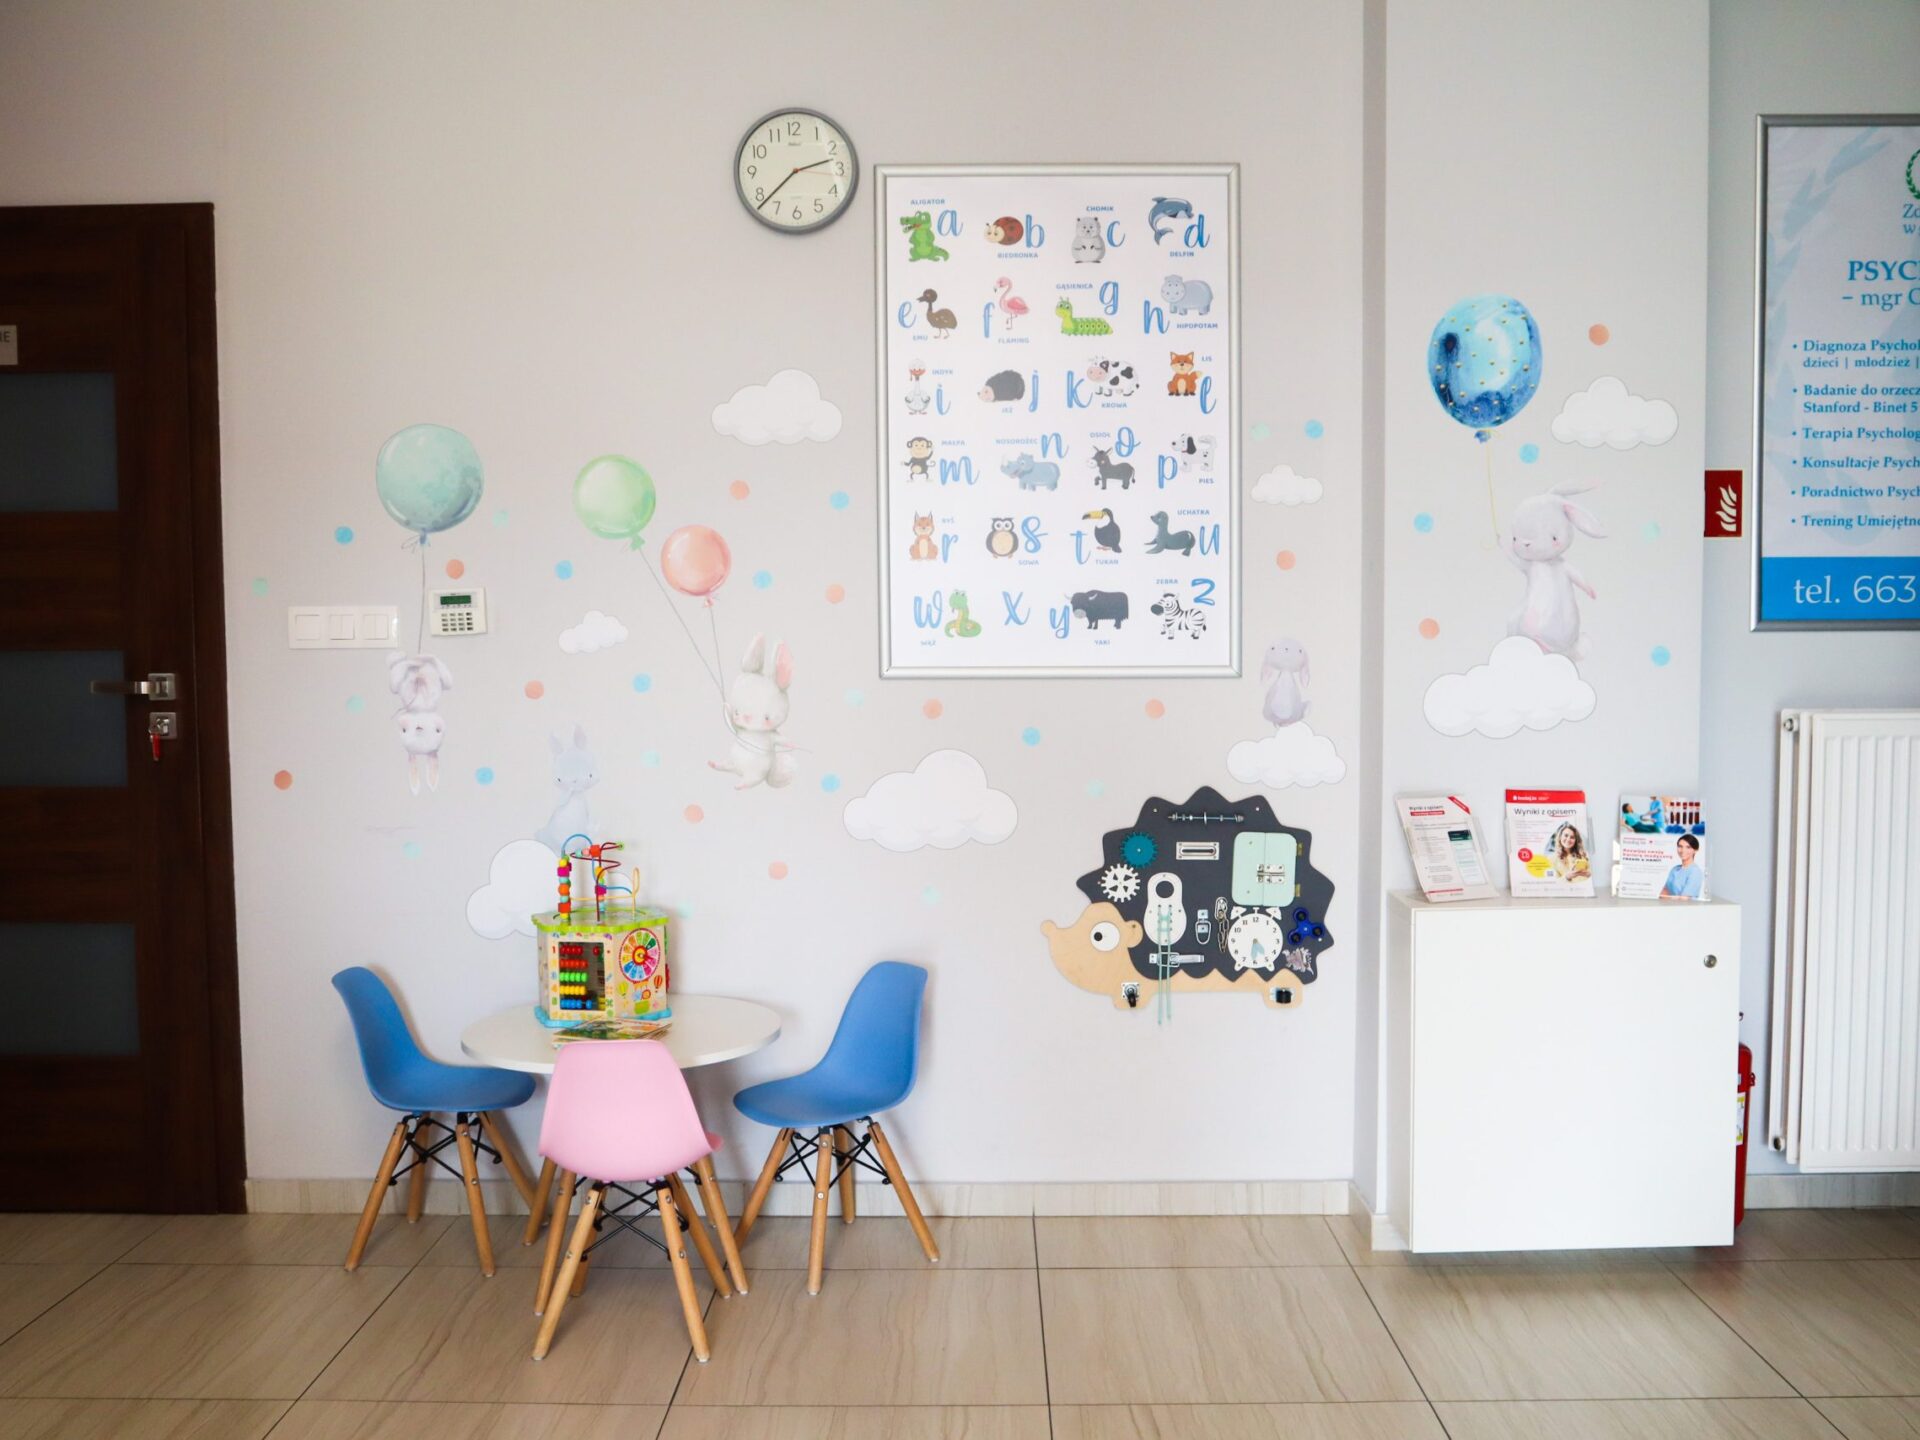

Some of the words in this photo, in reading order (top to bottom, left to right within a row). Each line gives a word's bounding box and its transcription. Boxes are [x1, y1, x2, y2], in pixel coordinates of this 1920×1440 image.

[769, 128, 780, 143] 11
[787, 121, 801, 136] 12
[815, 126, 819, 141] 1
[752, 144, 767, 159] 10
[827, 140, 837, 155] 2
[746, 165, 757, 179] 9
[835, 161, 846, 176] 3
[755, 187, 765, 202] 8
[828, 184, 838, 198] 4
[772, 200, 781, 215] 7
[792, 205, 802, 220] 6
[813, 198, 824, 213] 5
[937, 209, 964, 237] a
[1184, 213, 1211, 248] d
[1025, 214, 1045, 248] b
[1106, 220, 1126, 248] c
[1848, 260, 1920, 281] PSYC
[1099, 280, 1119, 316] g
[1861, 292, 1903, 311] mgr
[897, 301, 917, 329] e
[982, 301, 995, 338] f
[1143, 299, 1170, 334] h
[1803, 340, 1866, 354] Diagnoza
[1803, 357, 1839, 368] dzieci
[1028, 369, 1039, 413] j
[1804, 384, 1857, 395] Badanie
[1861, 384, 1877, 395] do
[936, 384, 951, 416] i
[1803, 401, 1860, 413] Stanford
[1873, 401, 1907, 413] Binet
[1910, 402, 1918, 413] 5
[1803, 427, 1853, 441] Terapia
[1041, 432, 1069, 459] n
[939, 456, 981, 486] m
[1802, 456, 1879, 471] Konsultacje
[1801, 486, 1883, 497] Poradnictwo
[1802, 515, 1853, 529] Trening
[1070, 530, 1091, 565] t
[1794, 575, 1840, 603] tel.
[1853, 575, 1916, 603] 663
[1050, 605, 1070, 639] y
[1514, 808, 1540, 816] Wyniki
[1547, 809, 1577, 817] opisem
